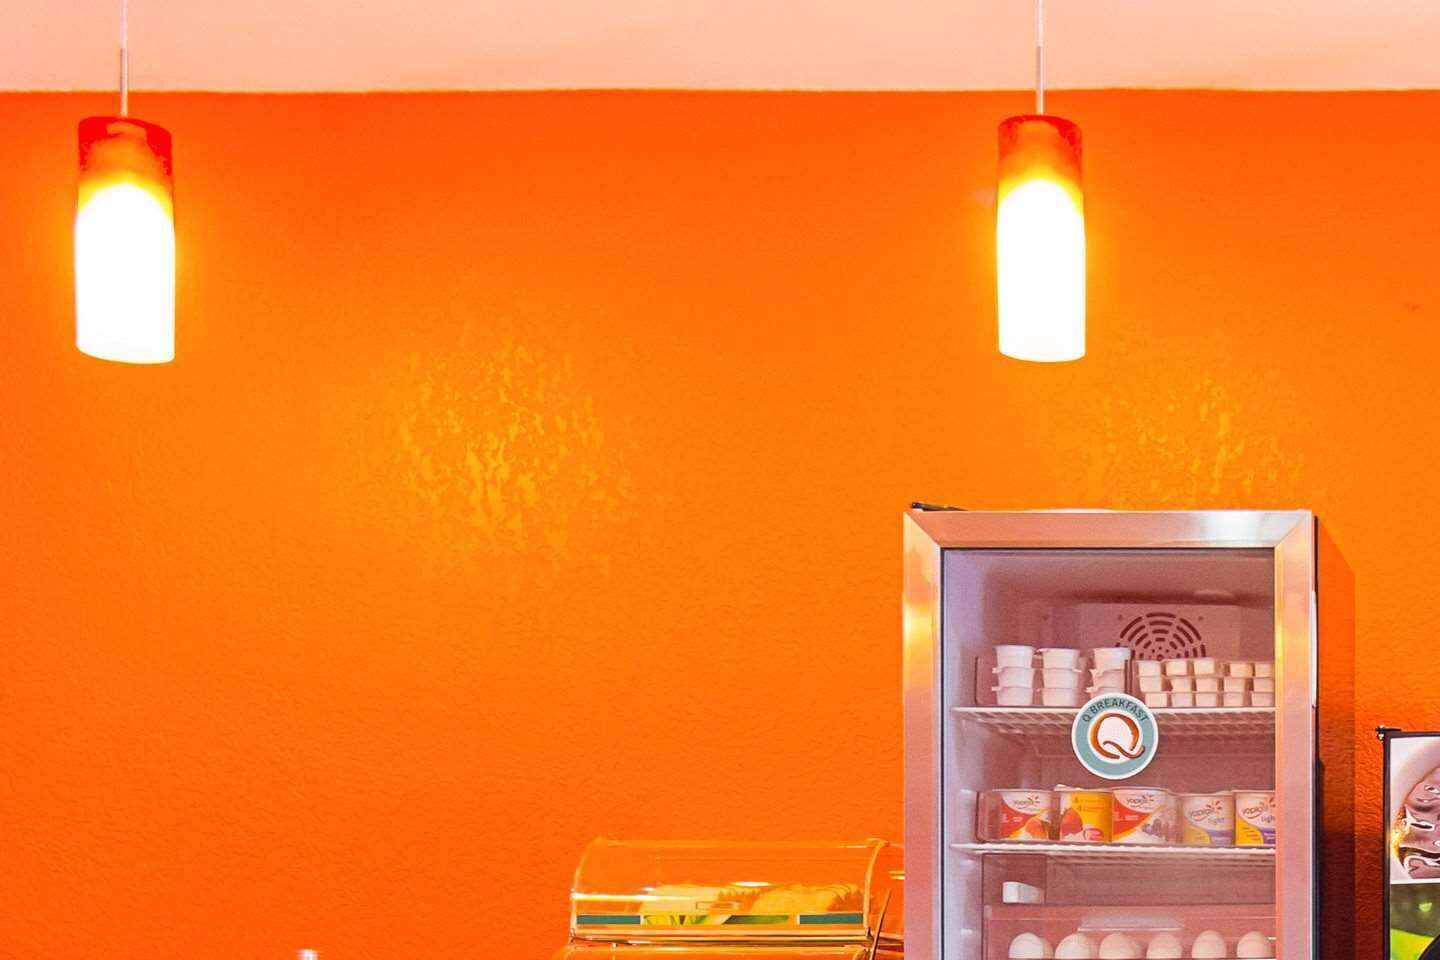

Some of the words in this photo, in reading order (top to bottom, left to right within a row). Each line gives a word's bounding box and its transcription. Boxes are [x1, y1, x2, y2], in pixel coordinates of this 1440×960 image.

[1082, 714, 1092, 722] Q
[1089, 698, 1149, 721] BREAKFAST
[1089, 713, 1146, 760] Q
